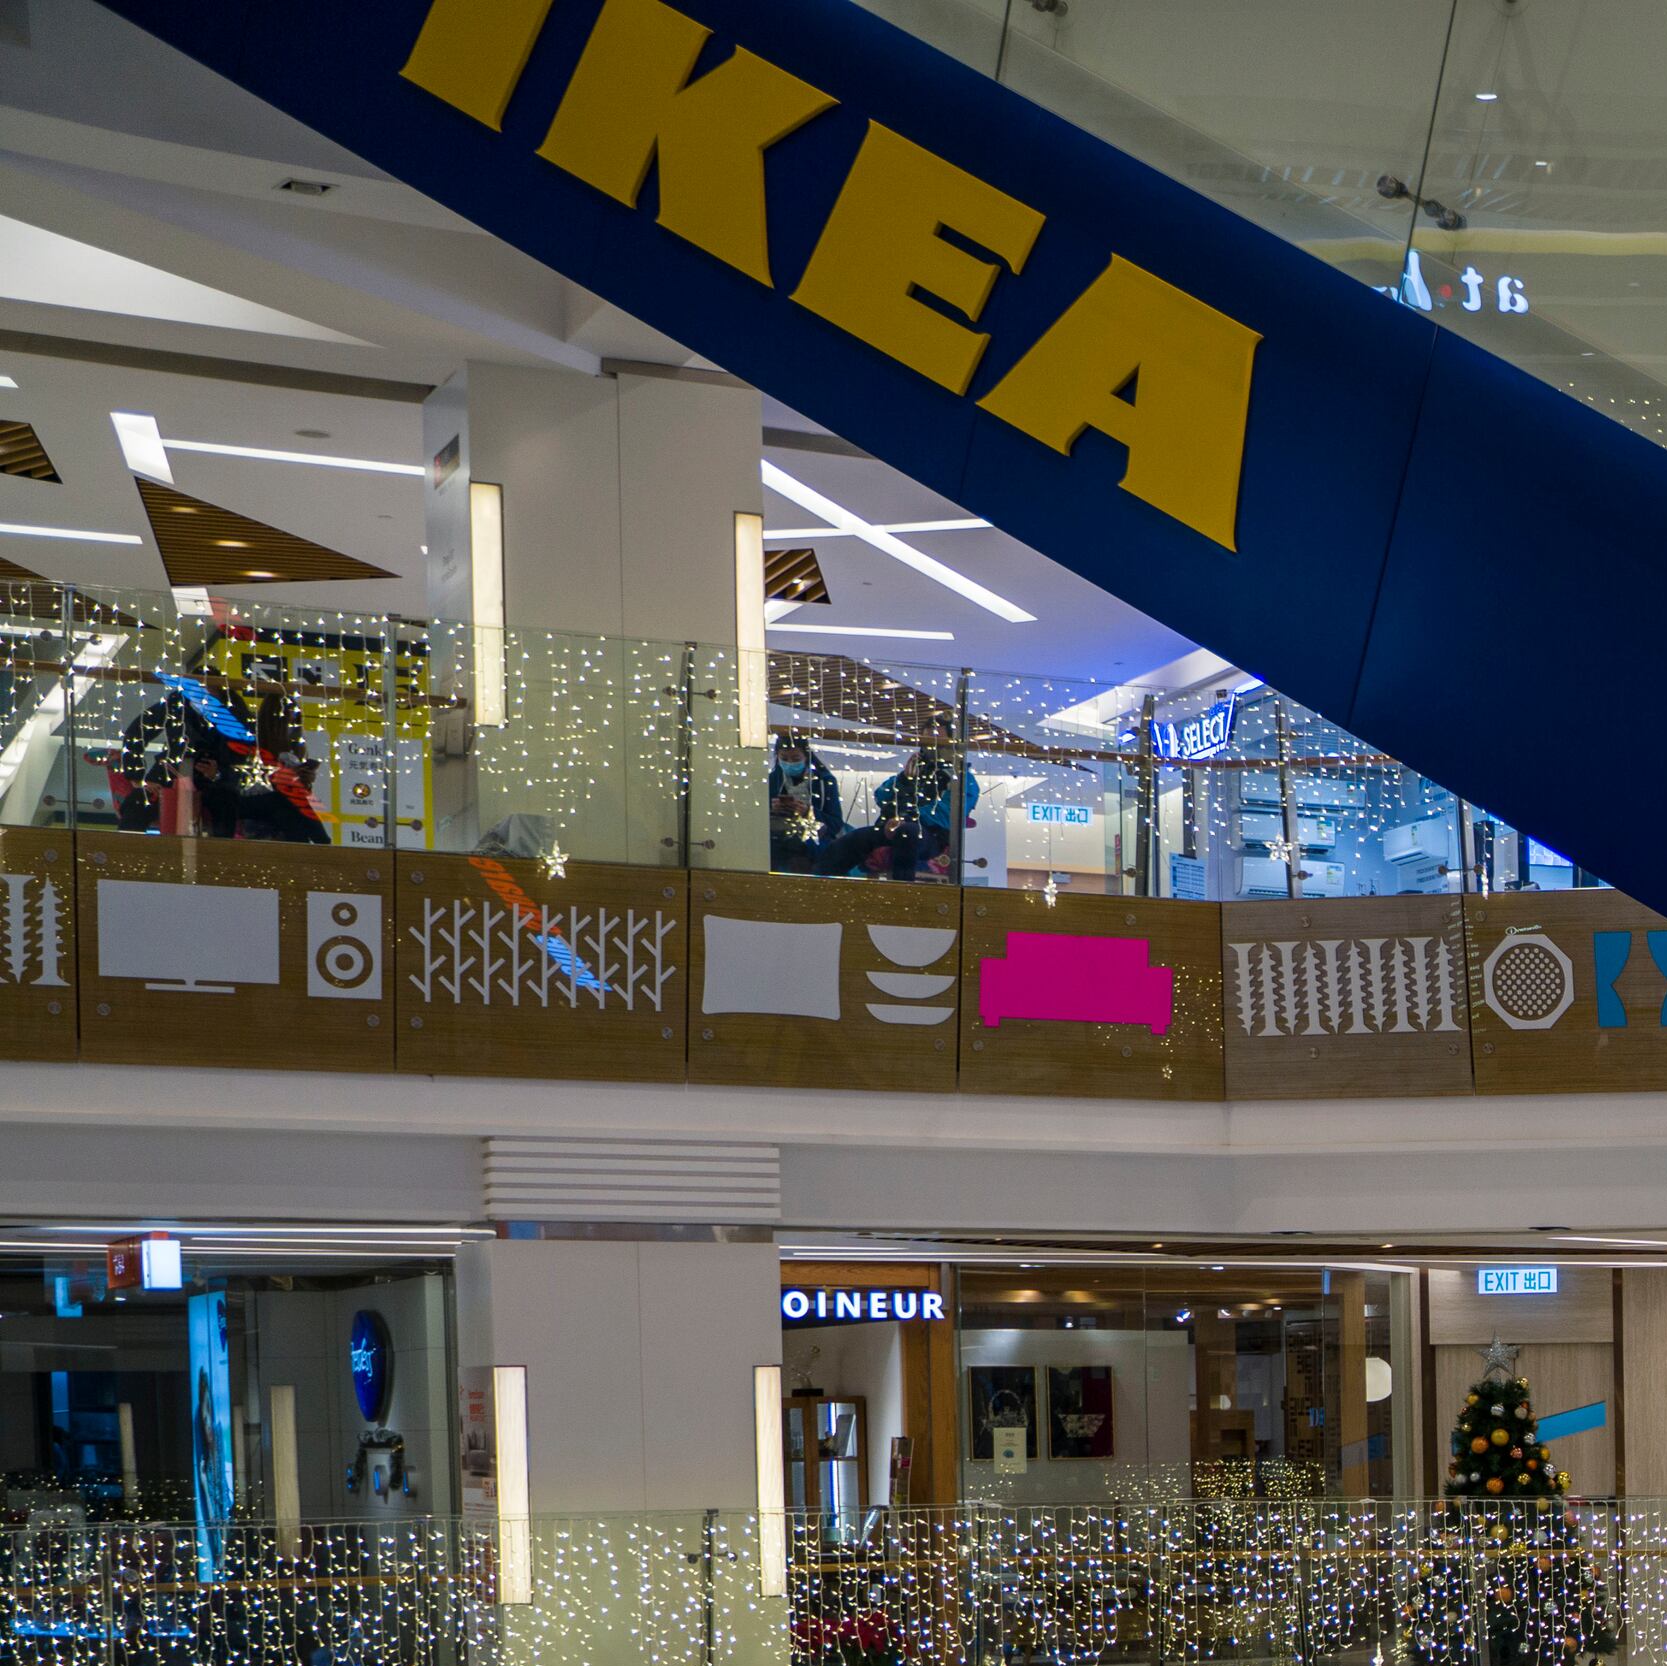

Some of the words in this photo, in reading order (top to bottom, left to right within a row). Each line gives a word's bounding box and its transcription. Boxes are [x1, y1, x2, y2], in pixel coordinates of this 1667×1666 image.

[400, 0, 1262, 551] IKEA
[1182, 711, 1225, 757] SELECT
[1032, 804, 1062, 822] EXIT
[1064, 807, 1089, 824] 出口
[1484, 1270, 1519, 1293] EXIT
[1523, 1271, 1551, 1292] 出口
[782, 1289, 945, 1321] OINEUR
